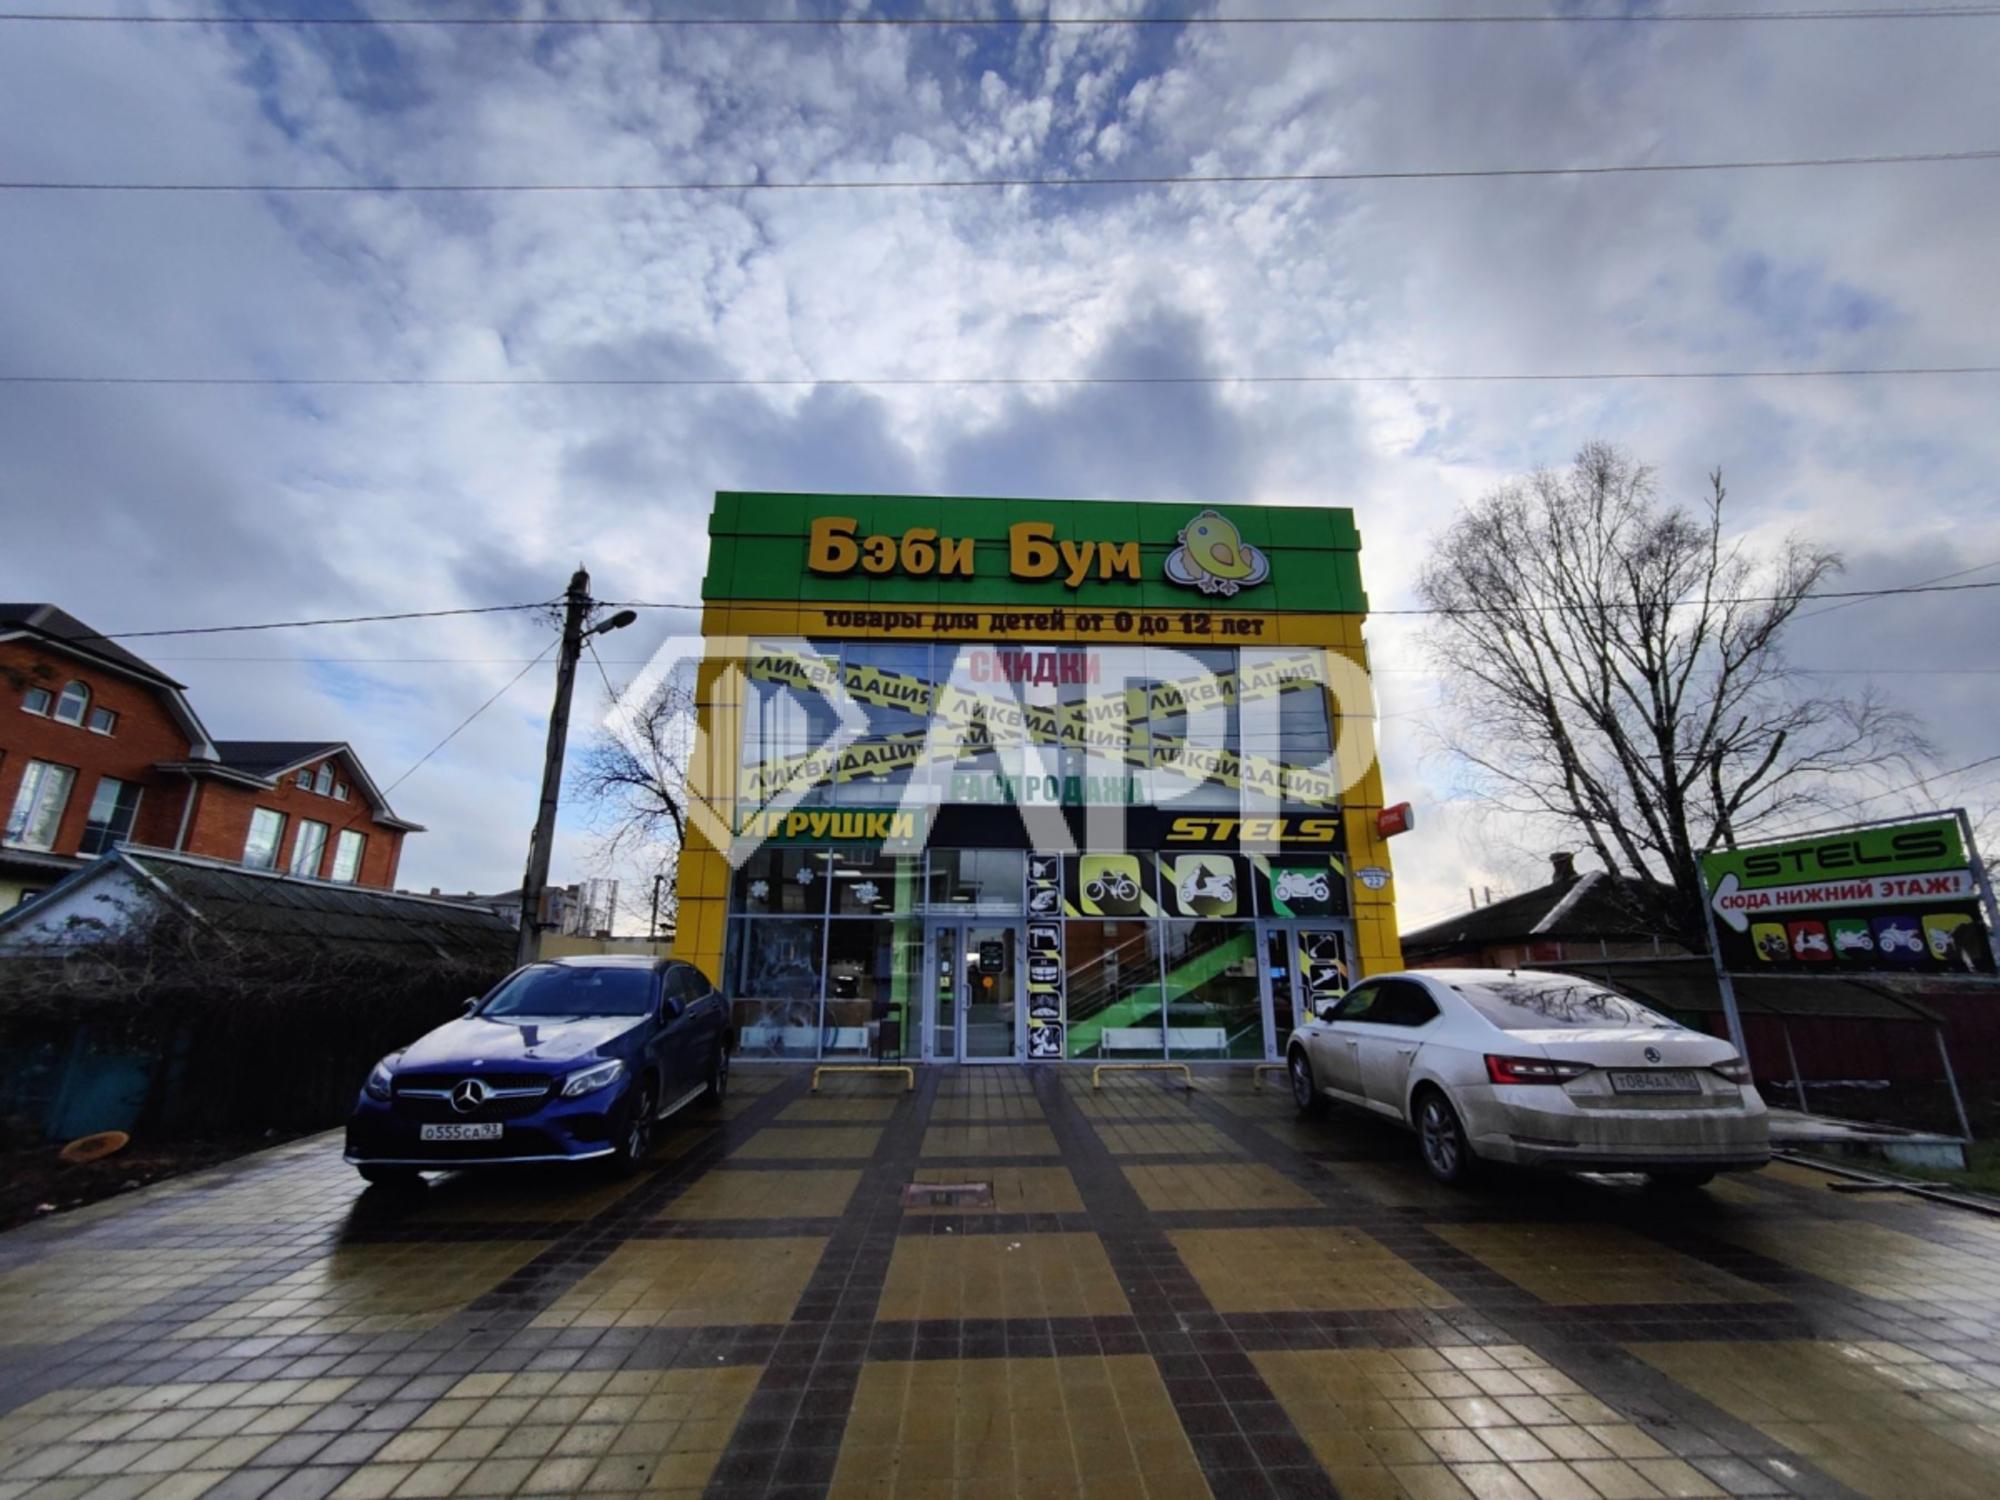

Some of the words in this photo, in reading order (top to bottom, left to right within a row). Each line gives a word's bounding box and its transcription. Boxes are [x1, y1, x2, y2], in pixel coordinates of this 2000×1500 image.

[808, 516, 975, 577] Бэби
[1009, 521, 1141, 587] Бум
[823, 610, 923, 631] товары
[932, 612, 979, 632] для
[990, 609, 1066, 633] детей
[1075, 614, 1104, 632] от
[1138, 615, 1169, 636] до
[1178, 613, 1211, 635] 12
[1220, 616, 1264, 635] лет
[969, 651, 1100, 687] СКИДКИ
[1151, 663, 1317, 710] ЛИКВИДАЦИЯ
[951, 774, 1144, 804] РАСПРОДАЖА
[1153, 748, 1329, 799] ЛИКВИДАЦИЯ
[740, 812, 914, 838] ИГРУШКИ
[1166, 818, 1339, 841] STELS
[1744, 830, 1948, 878] STELS
[1720, 891, 1771, 909] СЮДА
[1776, 880, 1873, 906] НИЖНИЙ
[1881, 876, 1961, 898] ЭТАЖ!
